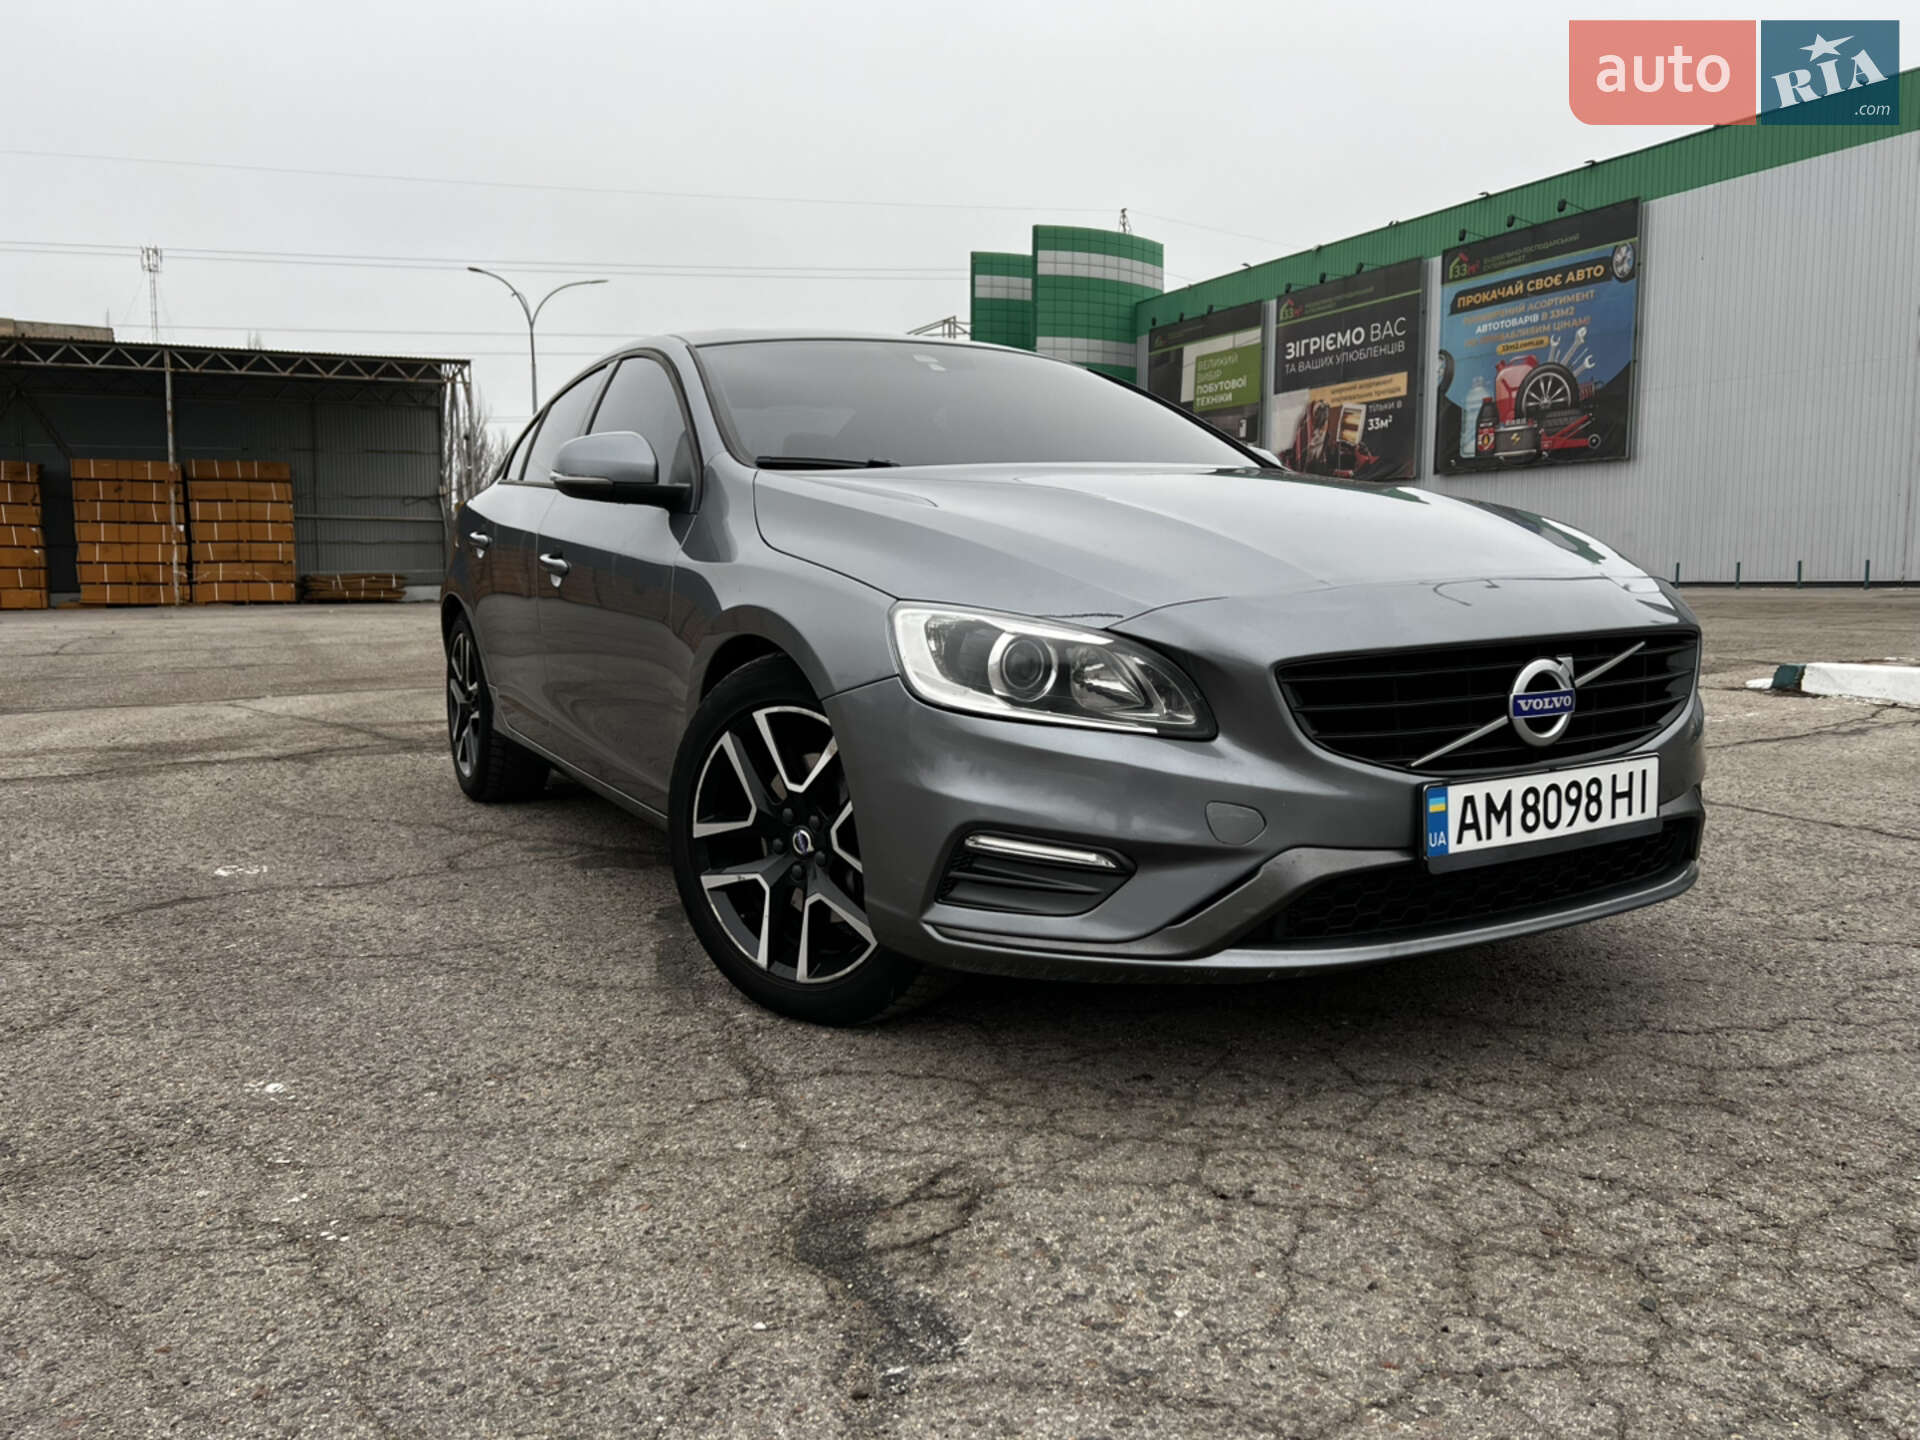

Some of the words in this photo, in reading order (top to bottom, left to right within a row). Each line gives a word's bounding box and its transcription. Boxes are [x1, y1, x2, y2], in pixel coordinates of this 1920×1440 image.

[1457, 282, 1524, 309] ПРОКАЧАЙ
[1527, 273, 1562, 293] СВОЄ
[1564, 264, 1605, 284] АВТО
[1527, 289, 1595, 312] АСОРТИМЕНТ
[1475, 314, 1540, 335] АВТОТОВАРІВ
[1285, 327, 1365, 360] ЗІГРІЄМО
[1370, 317, 1407, 342] ВАС
[1285, 363, 1297, 375] ТА
[1298, 355, 1334, 373] ВАШИХ
[1336, 340, 1406, 365] УЛЮБЛЕНЦІВ
[1517, 695, 1572, 712] VOLVO
[1428, 831, 1447, 848] UA
